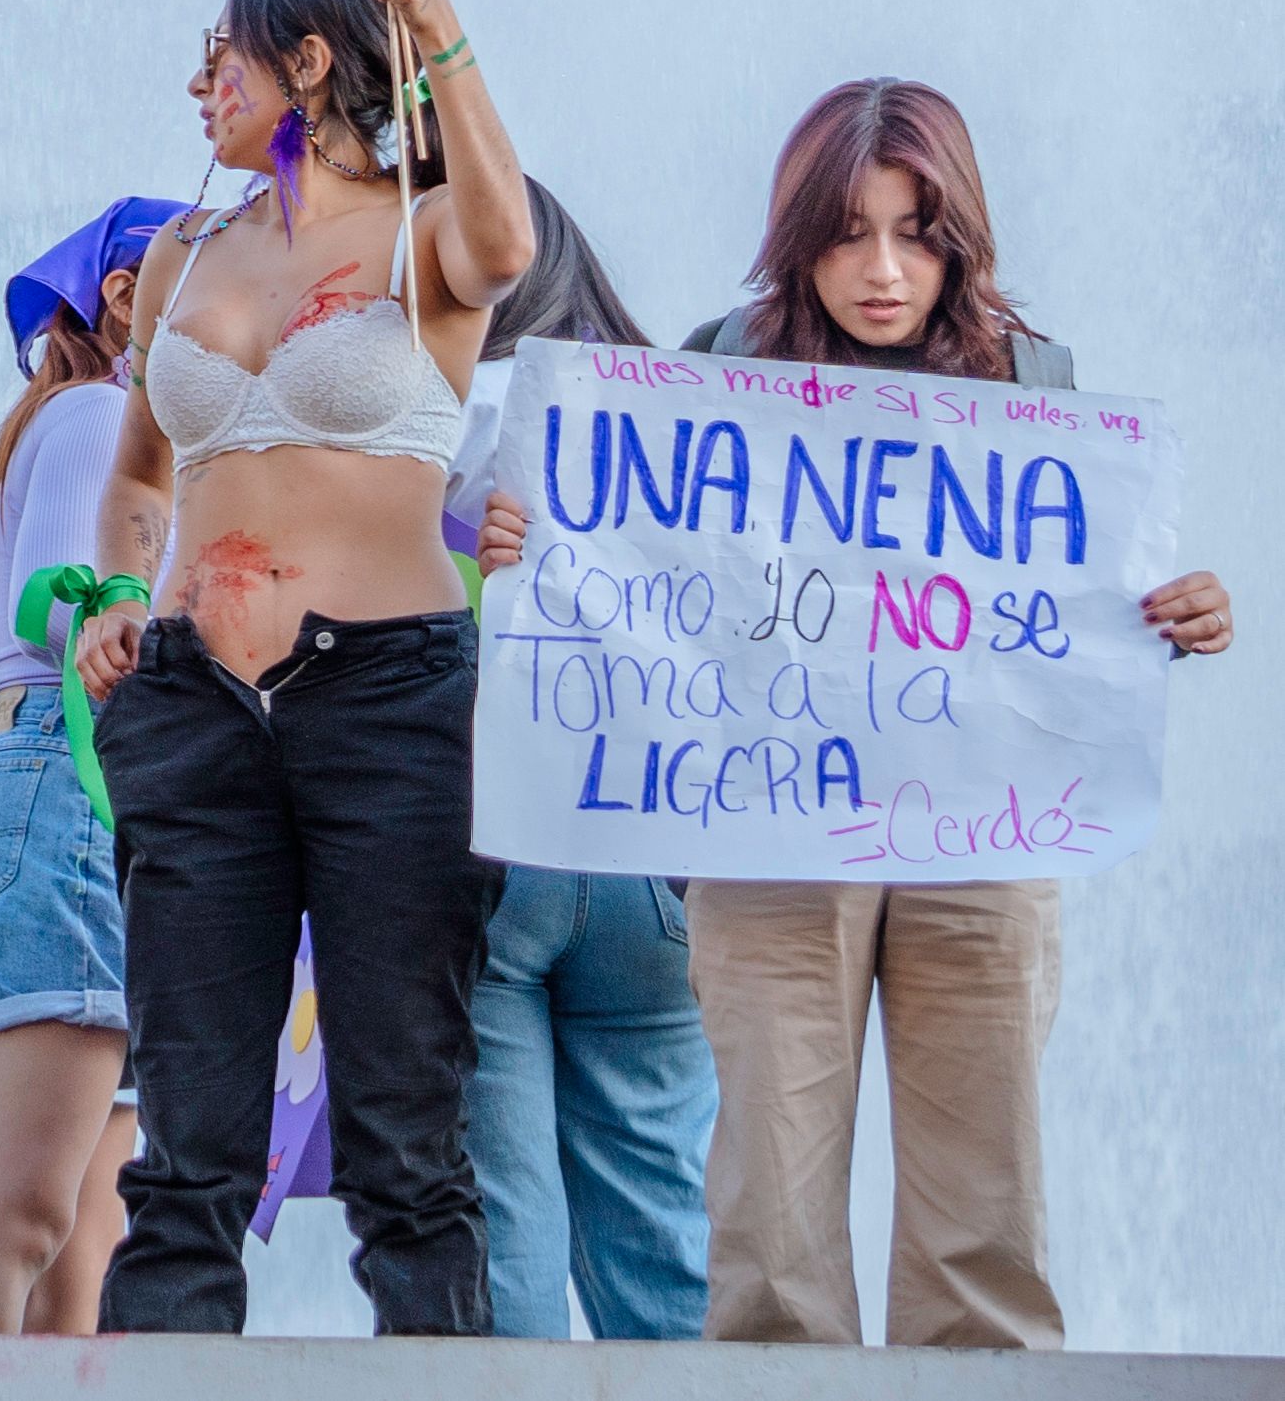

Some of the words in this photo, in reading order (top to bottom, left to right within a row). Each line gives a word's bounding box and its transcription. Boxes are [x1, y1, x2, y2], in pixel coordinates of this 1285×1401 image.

[723, 366, 856, 409] madre
[546, 404, 749, 534] UNA
[779, 434, 1087, 565] NENA
[868, 569, 972, 654] NO
[493, 634, 744, 733] Toma
[767, 662, 833, 730] a
[575, 733, 865, 830] LIGERA
